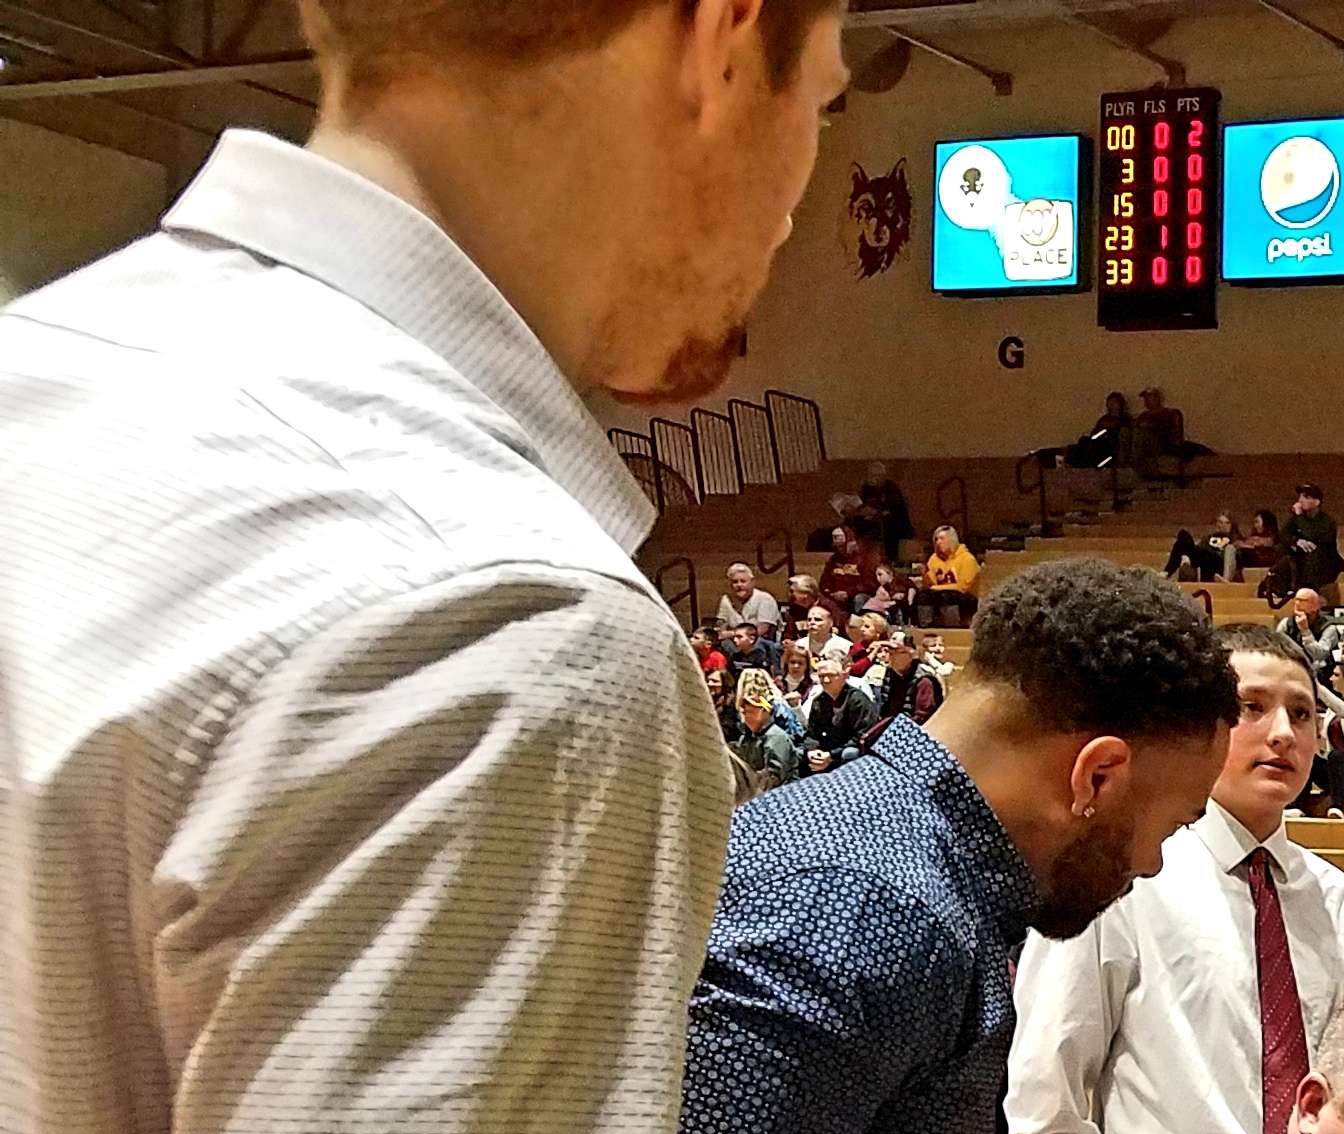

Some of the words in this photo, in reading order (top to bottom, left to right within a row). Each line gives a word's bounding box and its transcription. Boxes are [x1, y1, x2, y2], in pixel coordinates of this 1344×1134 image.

[1105, 102, 1135, 117] PLYR
[1144, 100, 1166, 114] FLS
[1177, 97, 1200, 112] PTS
[1107, 125, 1135, 150] 00
[1154, 122, 1170, 149] 0
[1188, 120, 1203, 147] 2
[1122, 158, 1134, 184] 3
[1153, 156, 1168, 182] 0
[1187, 154, 1202, 181] 0
[1113, 192, 1134, 217] 15
[1153, 190, 1168, 217] 0
[1187, 188, 1202, 214] 0
[1105, 225, 1134, 251] 23
[1161, 225, 1168, 250] 1
[1187, 222, 1202, 248] 0
[1267, 232, 1333, 263] pepsi
[1106, 258, 1133, 285] 33
[1152, 256, 1168, 284] 0
[1186, 256, 1201, 283] 0
[998, 336, 1024, 369] G
